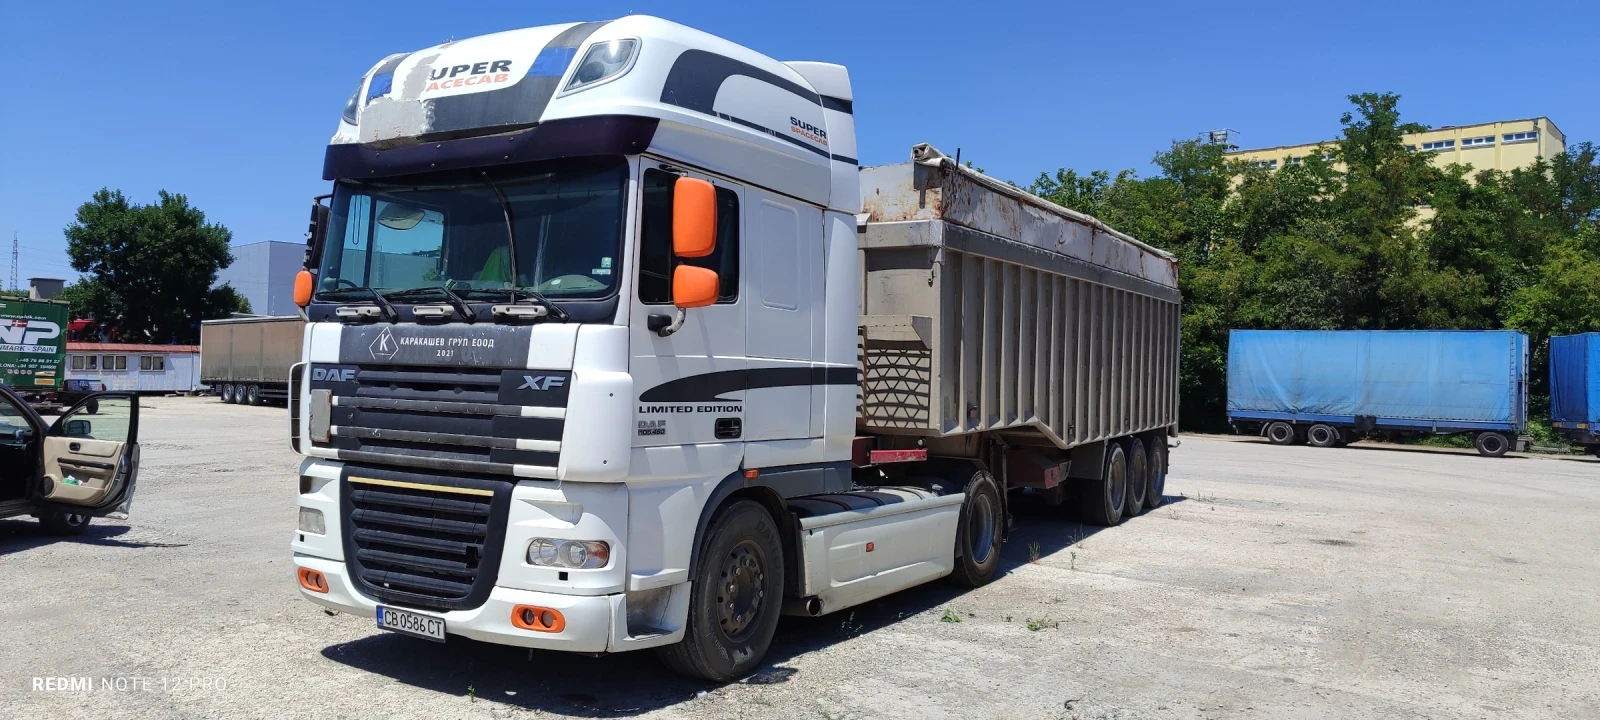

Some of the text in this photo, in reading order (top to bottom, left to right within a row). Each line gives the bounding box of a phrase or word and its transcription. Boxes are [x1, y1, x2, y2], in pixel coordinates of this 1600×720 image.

[429, 60, 513, 81] UPER
[426, 74, 509, 92] ACECAB
[790, 116, 826, 138] SUPER
[790, 126, 828, 146] SPACECAB
[379, 333, 391, 351] К
[400, 337, 495, 348] КАРАКАШЕВ ГРУП ЕООД
[436, 349, 455, 357] 2021
[312, 368, 357, 382] DAF
[516, 375, 567, 391] XF
[696, 405, 743, 413] EDITION
[638, 420, 666, 429] DAF
[384, 611, 399, 626] CB
[400, 613, 426, 632] 0586
[427, 619, 442, 636] CT
